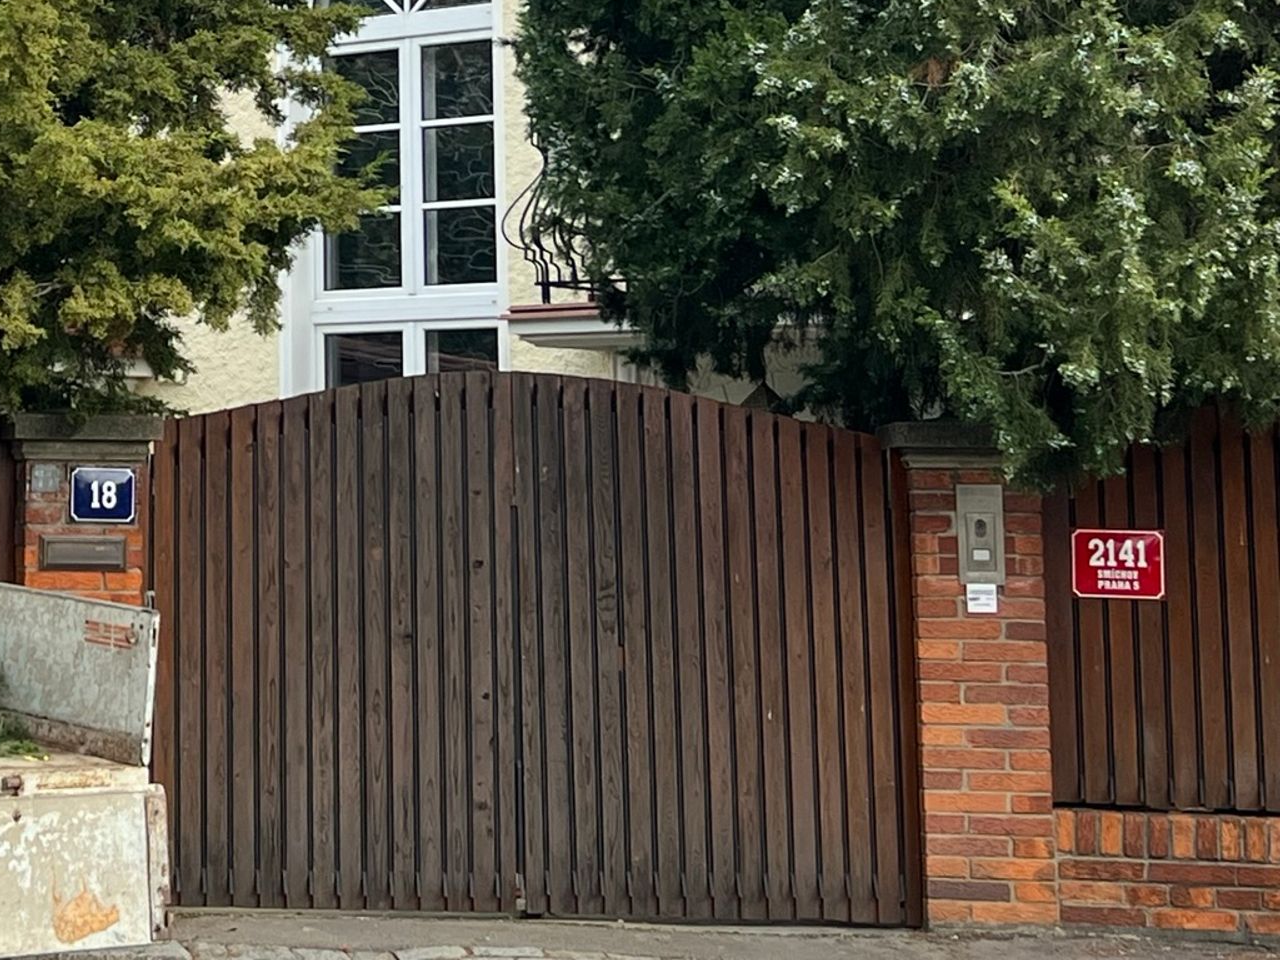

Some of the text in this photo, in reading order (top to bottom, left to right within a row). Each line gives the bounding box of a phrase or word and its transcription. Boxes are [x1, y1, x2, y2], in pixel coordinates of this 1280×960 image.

[90, 480, 117, 509] 18
[1088, 538, 1148, 568] 2141
[1098, 580, 1131, 590] PRAHA
